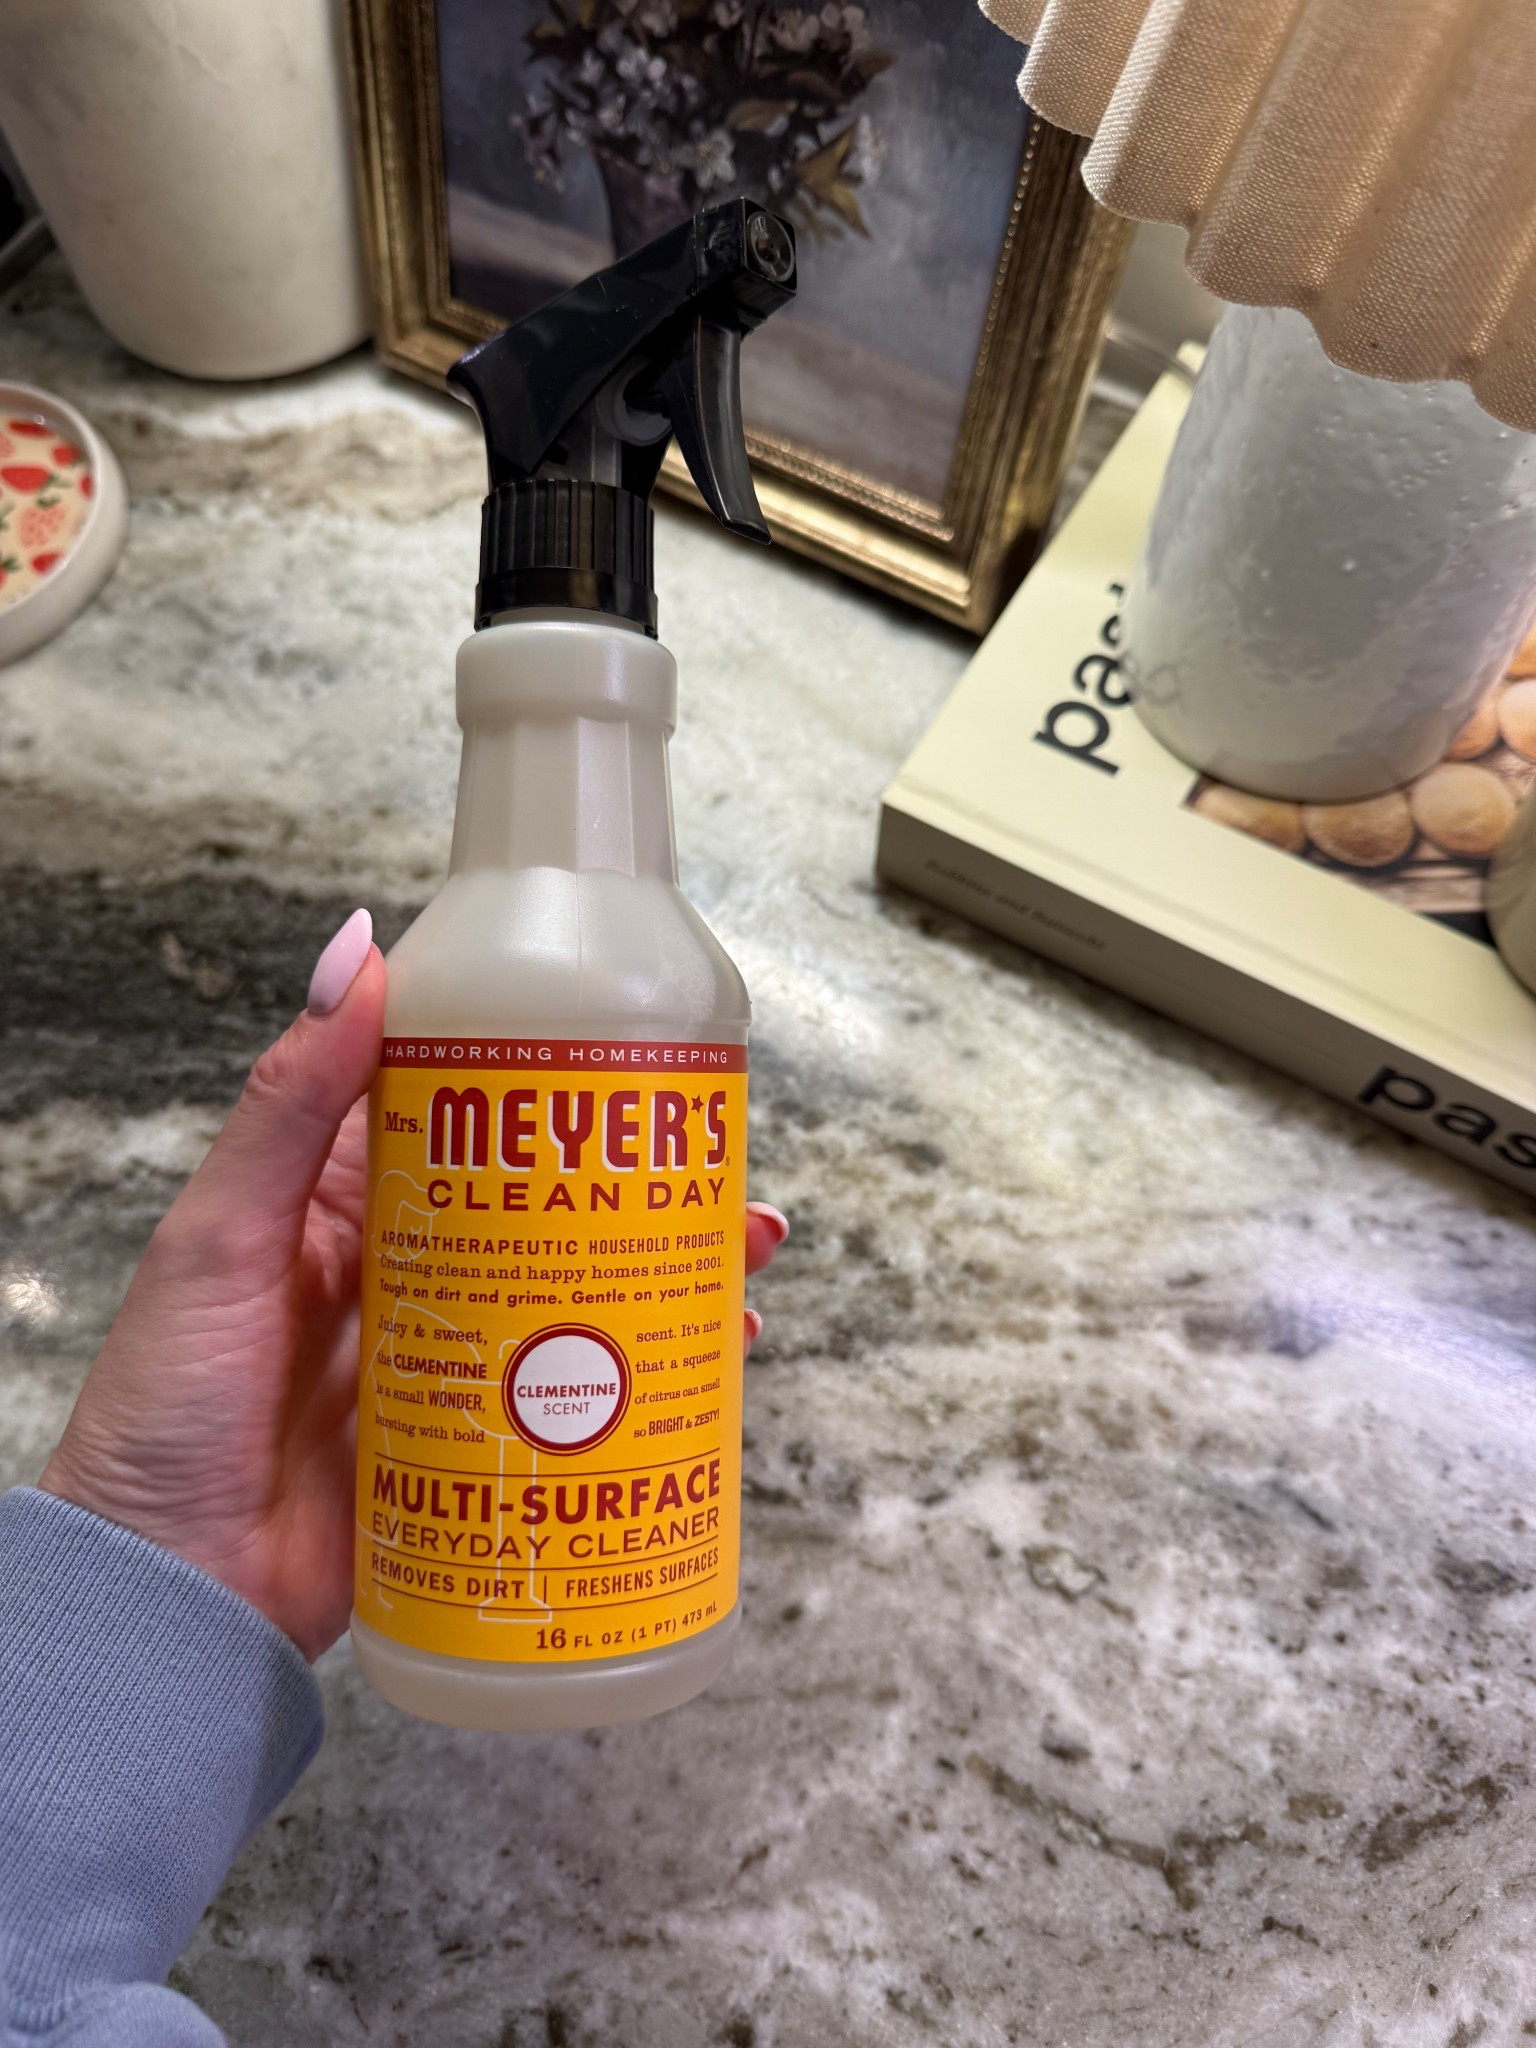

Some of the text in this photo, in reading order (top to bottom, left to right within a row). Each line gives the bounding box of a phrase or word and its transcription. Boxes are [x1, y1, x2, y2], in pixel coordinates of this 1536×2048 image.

[385, 1044, 728, 1064] HARDWORKING HOMEKEEPING
[384, 1112, 424, 1134] Mrs.
[427, 1177, 726, 1212] CLEAN DAY
[380, 1229, 724, 1256] AROMATHERAPEUTIC HOUSEHOLD PRODUCTS
[381, 1254, 724, 1283] Creating clean and happy homes since 2001.
[380, 1278, 724, 1308] Tough on dirt and grime. Gentle on your home.
[378, 1315, 488, 1346] Juicy & sweet,
[636, 1319, 722, 1342] scent. It's nice
[377, 1350, 487, 1379] the CLEMENTINE
[636, 1349, 721, 1373] that a squeeze
[376, 1381, 486, 1413] is a small WONDER,
[517, 1383, 616, 1398] CLEMENTINE
[635, 1378, 720, 1404] of citrus can smell
[543, 1402, 591, 1416] SCENT
[634, 1408, 720, 1438] so BRIGHT & ZESTY!
[375, 1411, 485, 1443] bursting with bold
[373, 1457, 721, 1526] MULTI-SURFACE
[372, 1506, 720, 1560] EVERYDAY CLEANER
[372, 1553, 524, 1599] REMOVES DIRT
[566, 1547, 719, 1599] FRESHENS SURFACES
[536, 1603, 718, 1650] 16 FL OZ (1 PT) 473 mL
